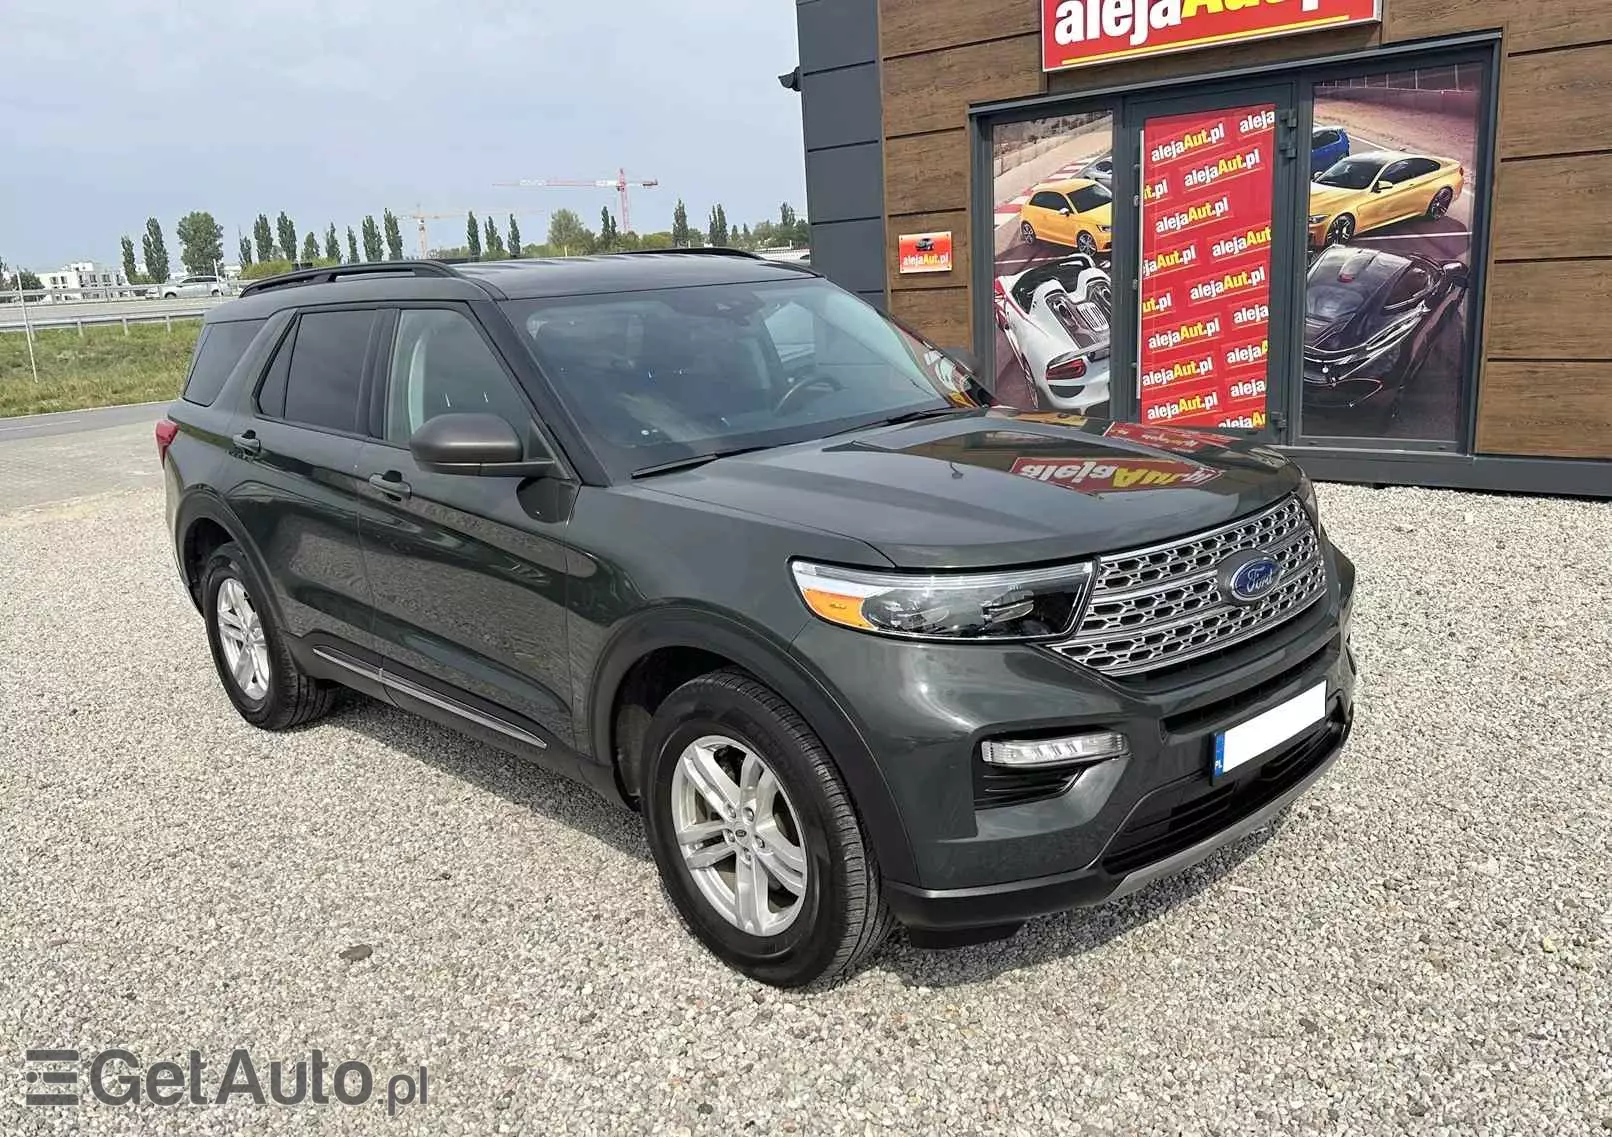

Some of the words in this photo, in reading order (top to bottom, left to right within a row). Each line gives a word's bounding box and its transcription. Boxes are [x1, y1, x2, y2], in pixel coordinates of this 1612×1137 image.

[1151, 123, 1225, 162] alejaAut.pl
[1183, 148, 1260, 187] alejaAut.pl
[1155, 197, 1229, 233] alejaAut.pl
[903, 252, 949, 266] alejaAut.pl
[1143, 245, 1197, 277] jaAut.pl
[1190, 266, 1266, 300] alejaAut.pl
[1233, 304, 1269, 324] aleja
[1148, 317, 1221, 349] alejaAut.pl
[1142, 356, 1213, 387] alejaAut.pl
[1230, 379, 1266, 397] aleja
[1147, 392, 1218, 420] alejaAut.pl
[1247, 566, 1273, 592] Ford
